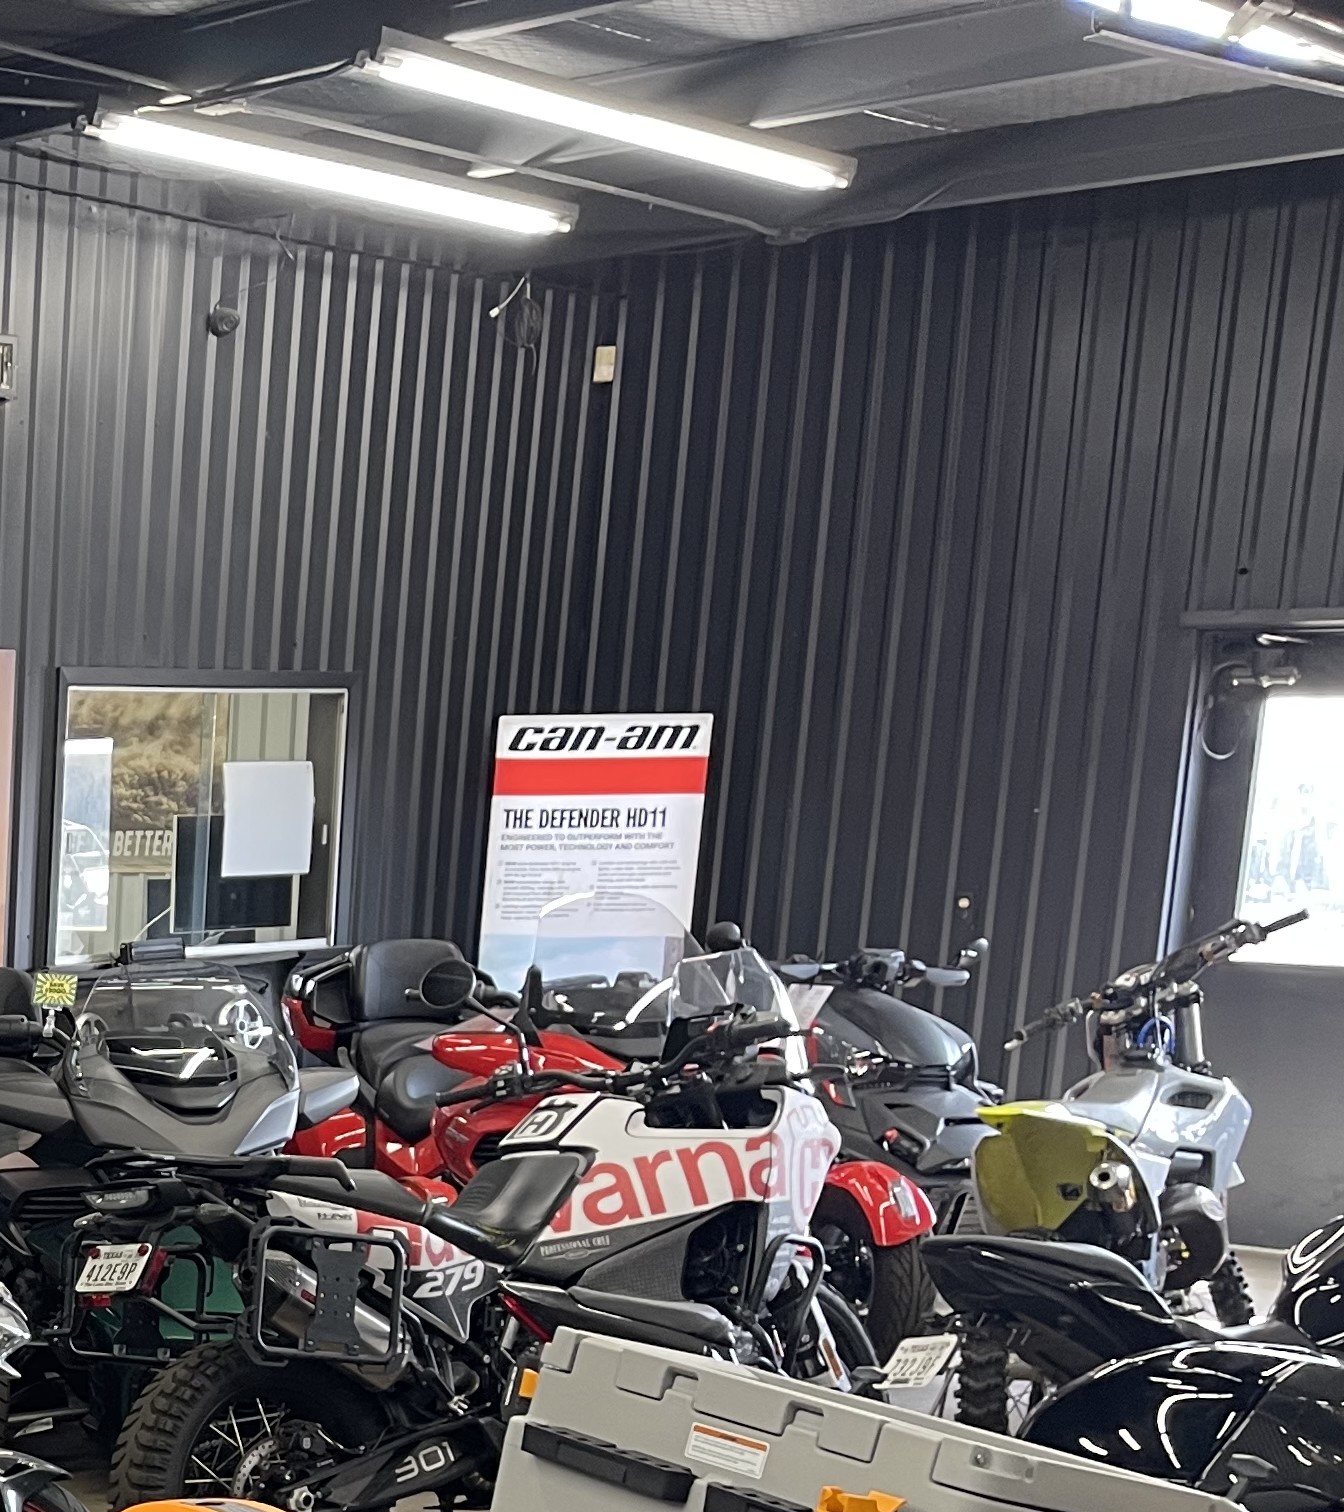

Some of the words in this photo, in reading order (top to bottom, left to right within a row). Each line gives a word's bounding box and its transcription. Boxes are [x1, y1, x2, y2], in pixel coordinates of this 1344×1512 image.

[508, 725, 700, 751] can-am
[504, 808, 534, 829] THE
[539, 807, 621, 829] DEFENDER
[626, 806, 668, 828] HD11
[113, 830, 174, 857] BETTER
[559, 843, 613, 851] TECHNOLOGY
[567, 832, 623, 841] OUTPERFORM
